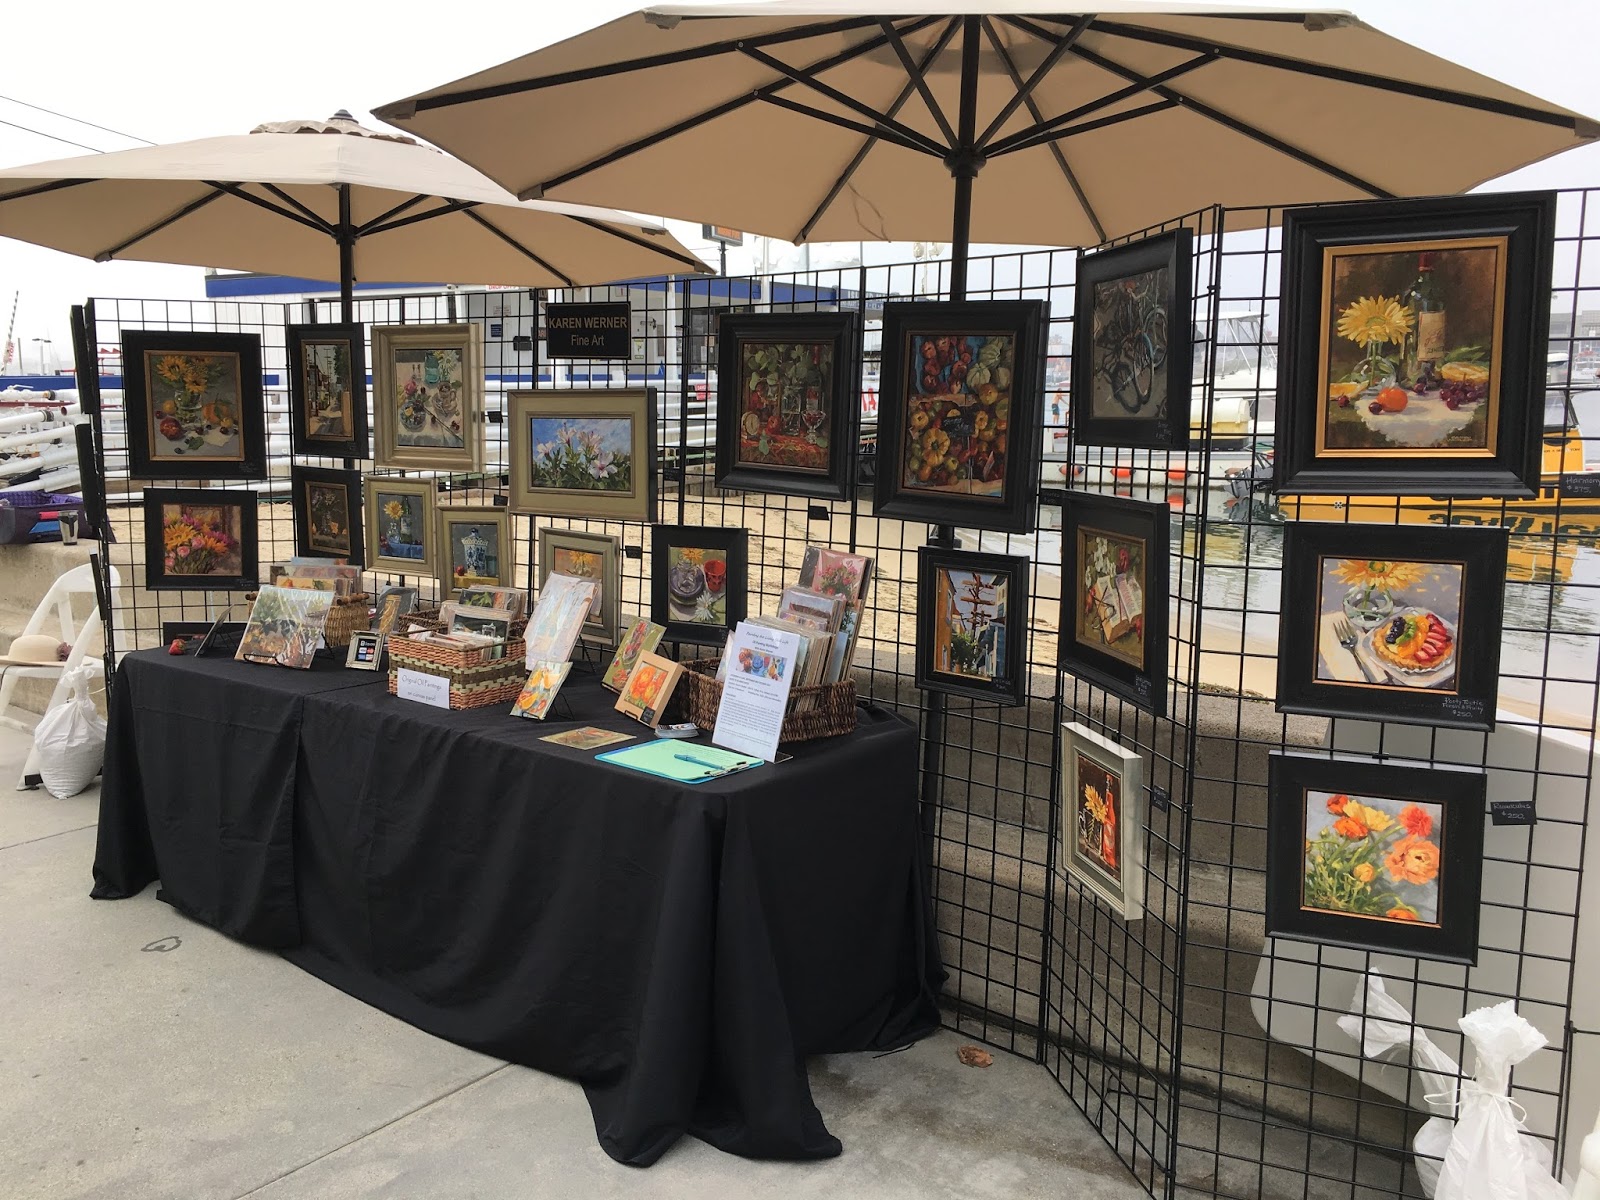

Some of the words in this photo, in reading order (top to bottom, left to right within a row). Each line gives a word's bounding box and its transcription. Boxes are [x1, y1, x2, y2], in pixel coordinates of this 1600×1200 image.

[549, 317, 581, 329] KAREN
[584, 316, 627, 329] WERNER
[571, 334, 589, 346] Fine
[591, 334, 605, 346] Art
